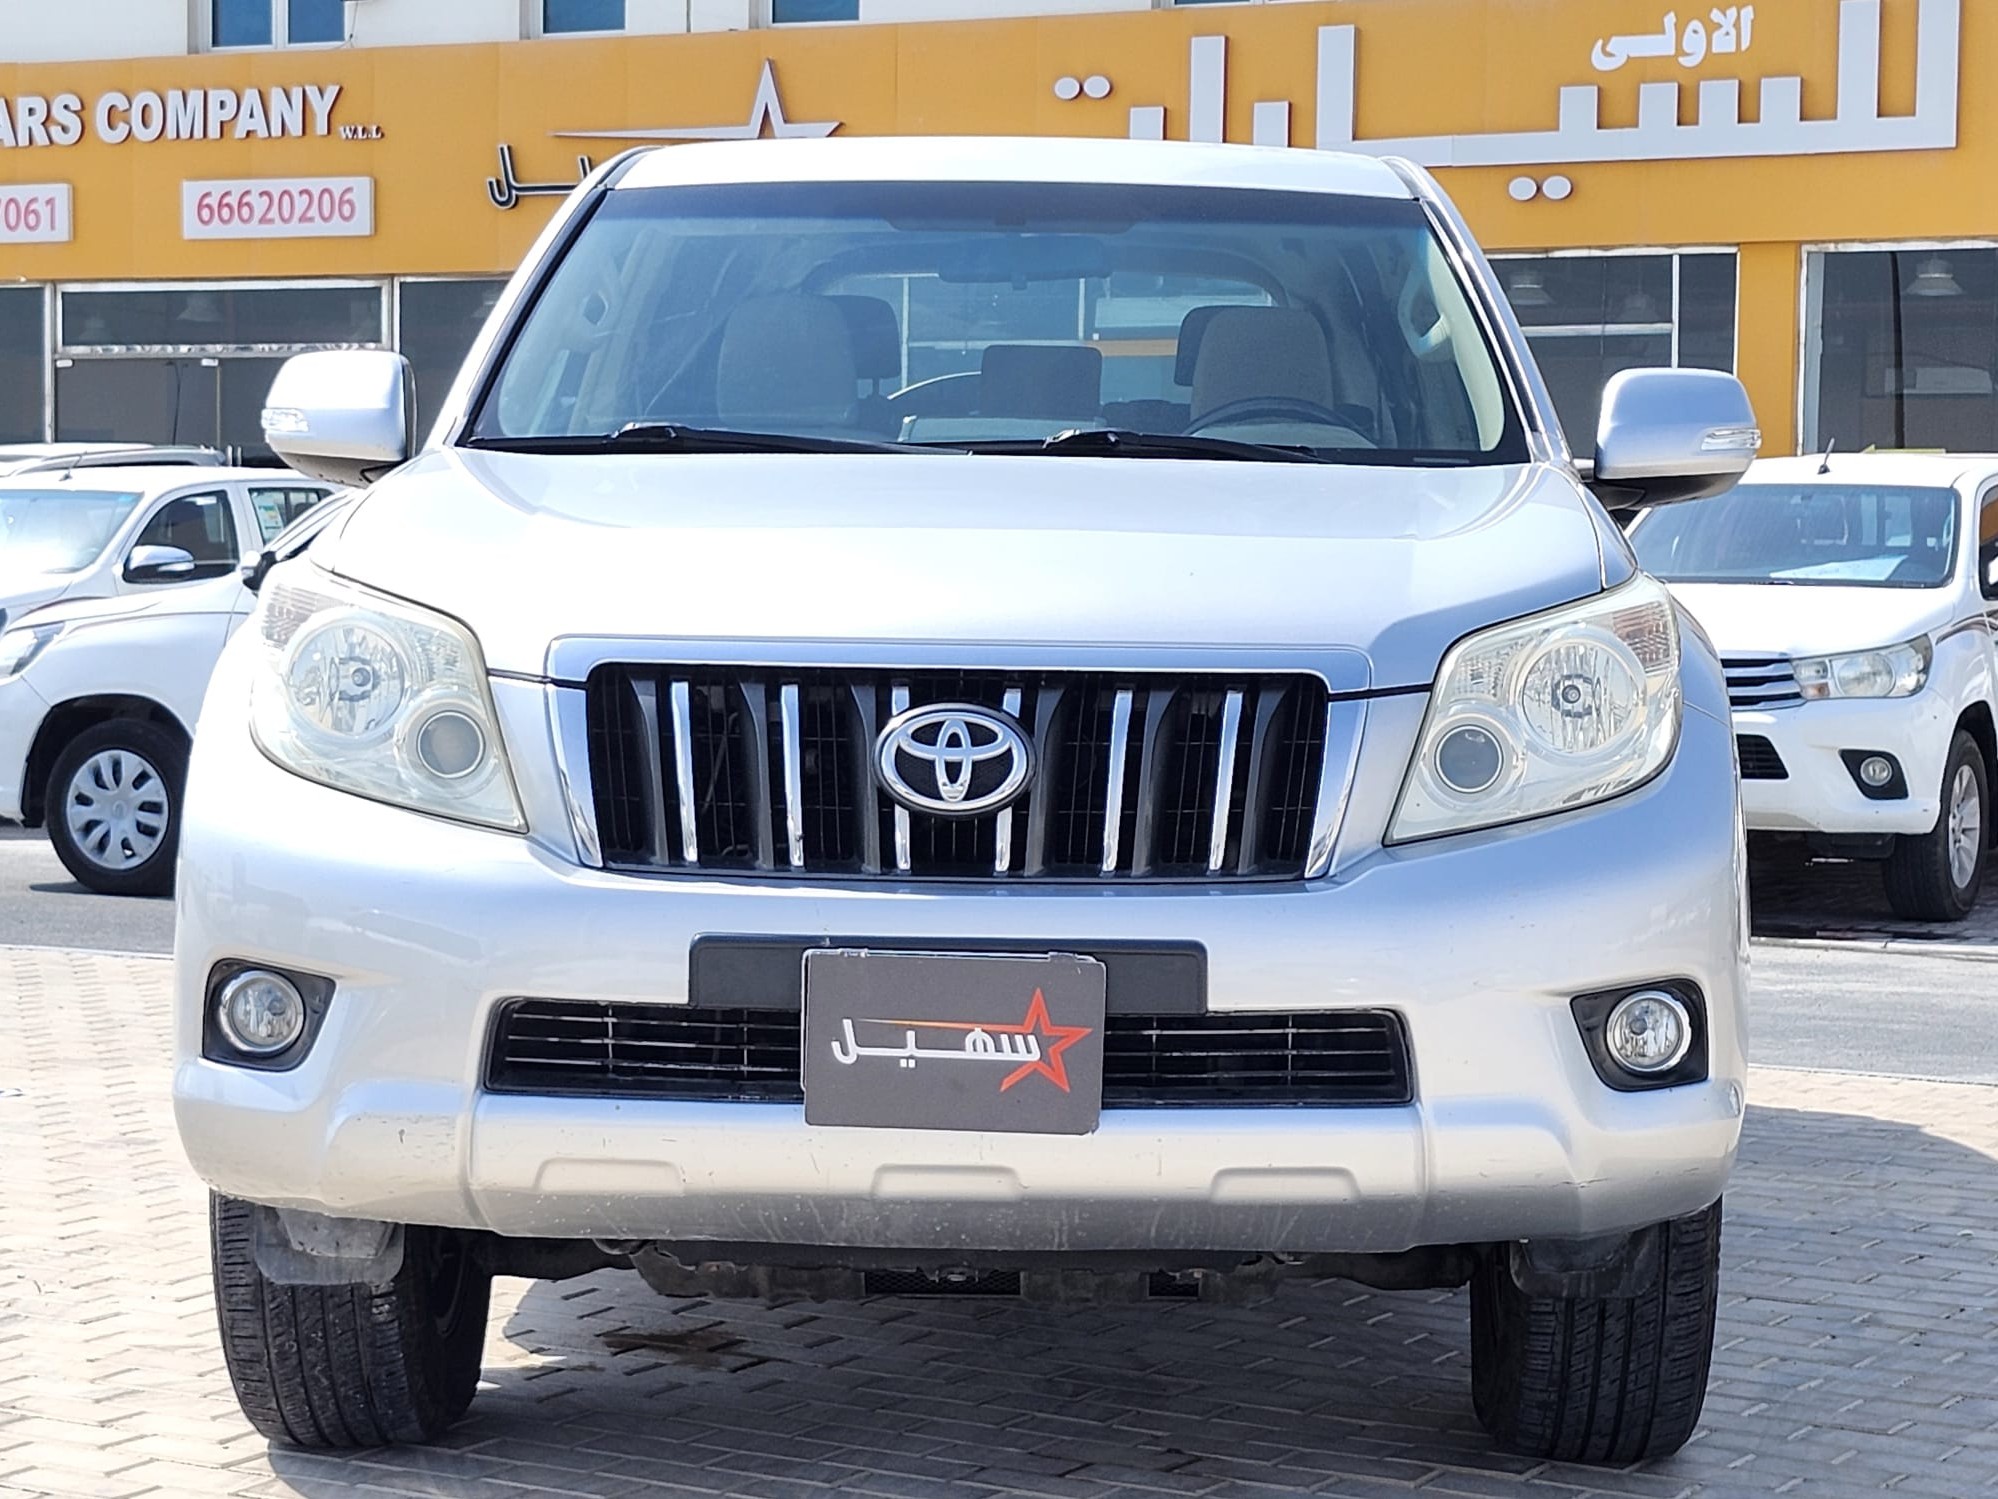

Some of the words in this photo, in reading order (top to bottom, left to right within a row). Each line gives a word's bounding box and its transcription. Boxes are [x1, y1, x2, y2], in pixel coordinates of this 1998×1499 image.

[96, 84, 341, 144] COMPANY
[0, 196, 57, 232] 061
[197, 186, 357, 226] 66620206
[831, 1018, 1041, 1068] سهيل
